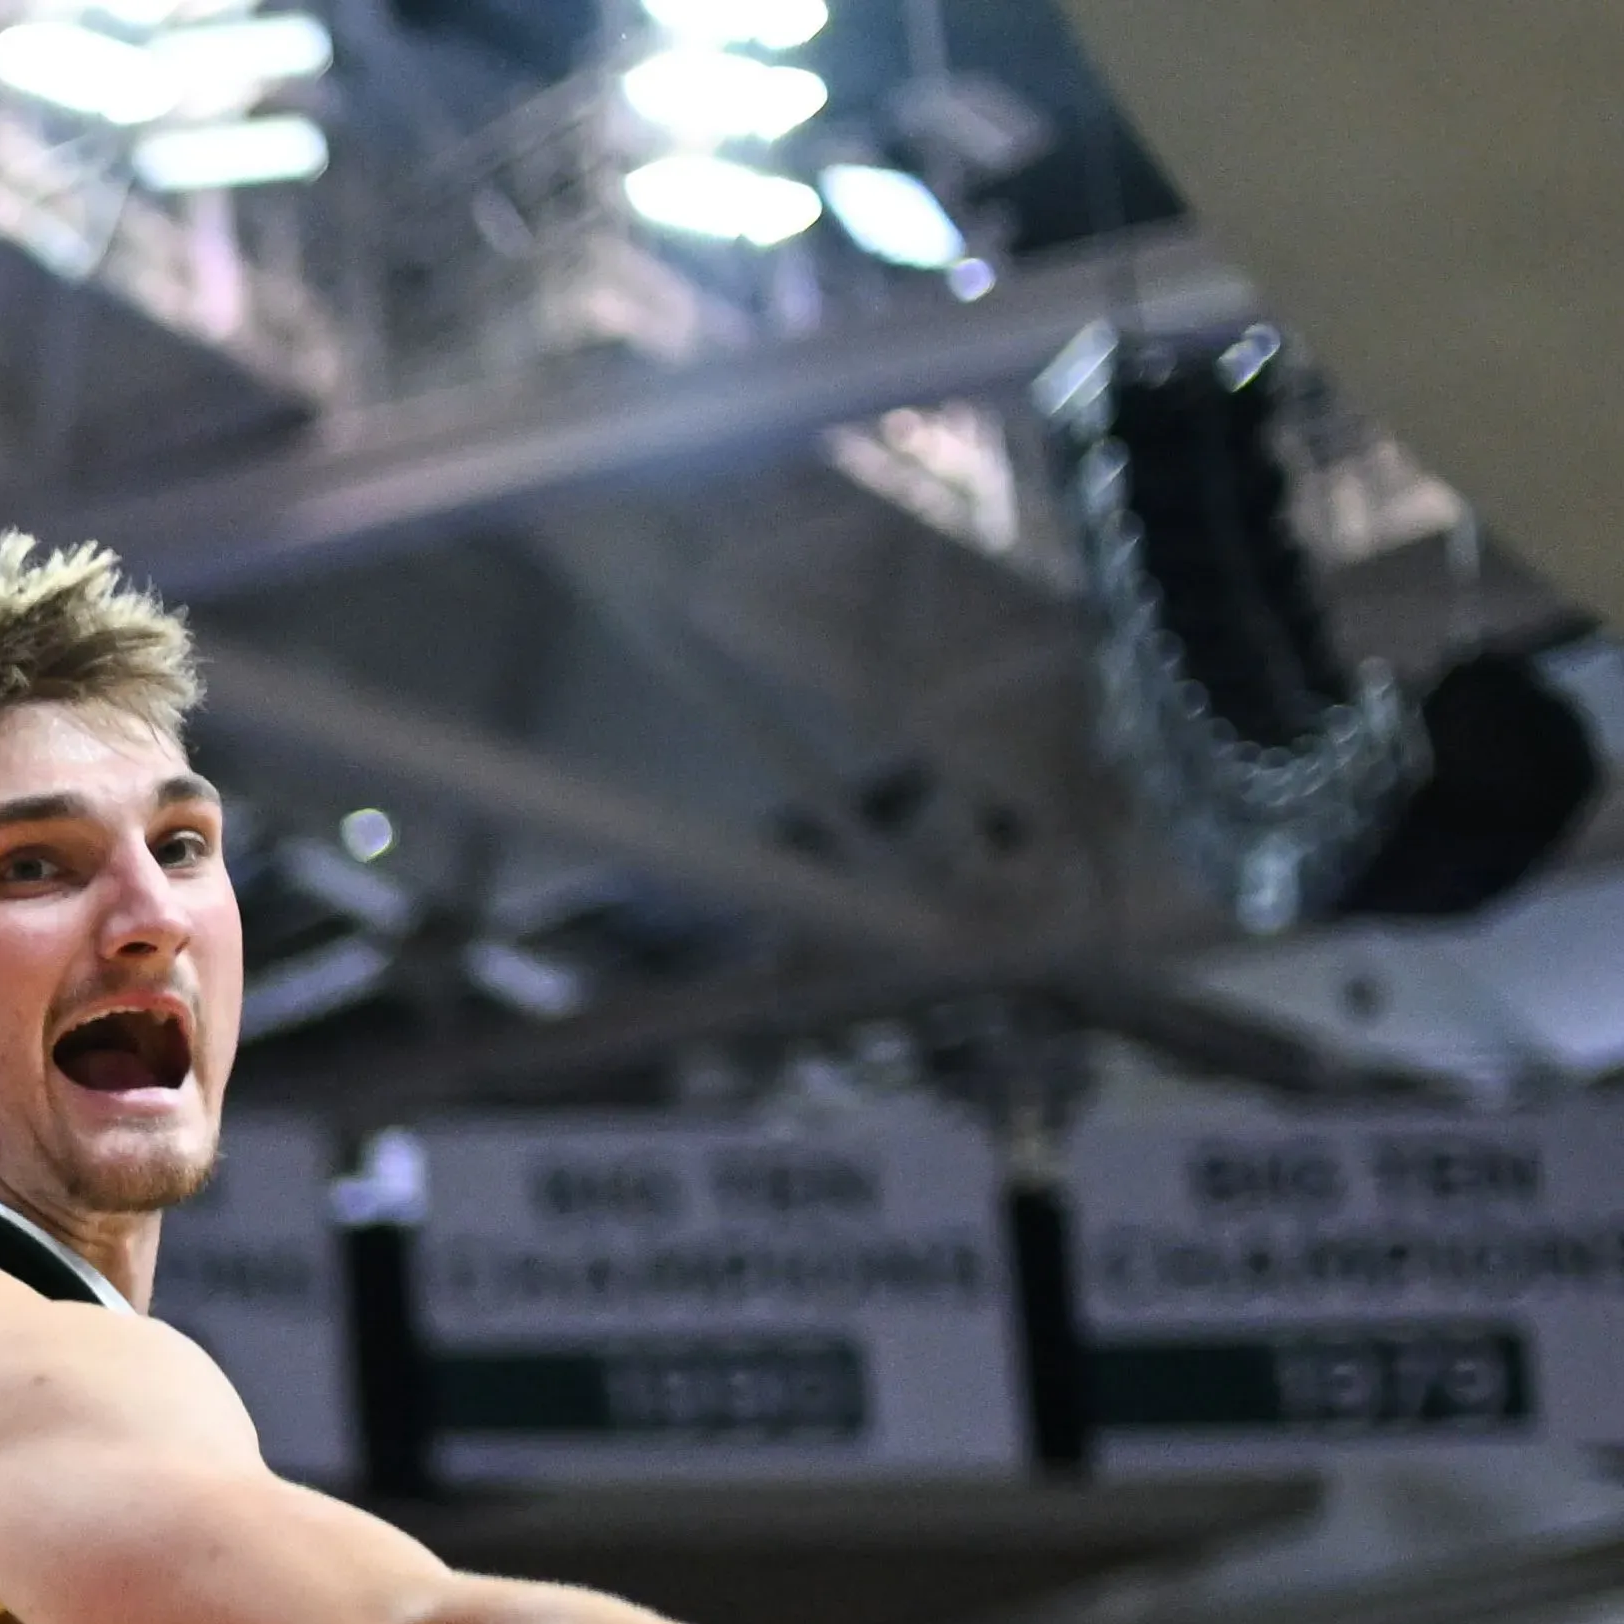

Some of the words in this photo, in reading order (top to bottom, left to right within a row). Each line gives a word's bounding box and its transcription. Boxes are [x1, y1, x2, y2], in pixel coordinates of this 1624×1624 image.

[534, 1153, 681, 1221] BIG
[710, 1144, 884, 1211] TEN
[1189, 1136, 1345, 1204] BIG
[1375, 1131, 1539, 1196] TEN
